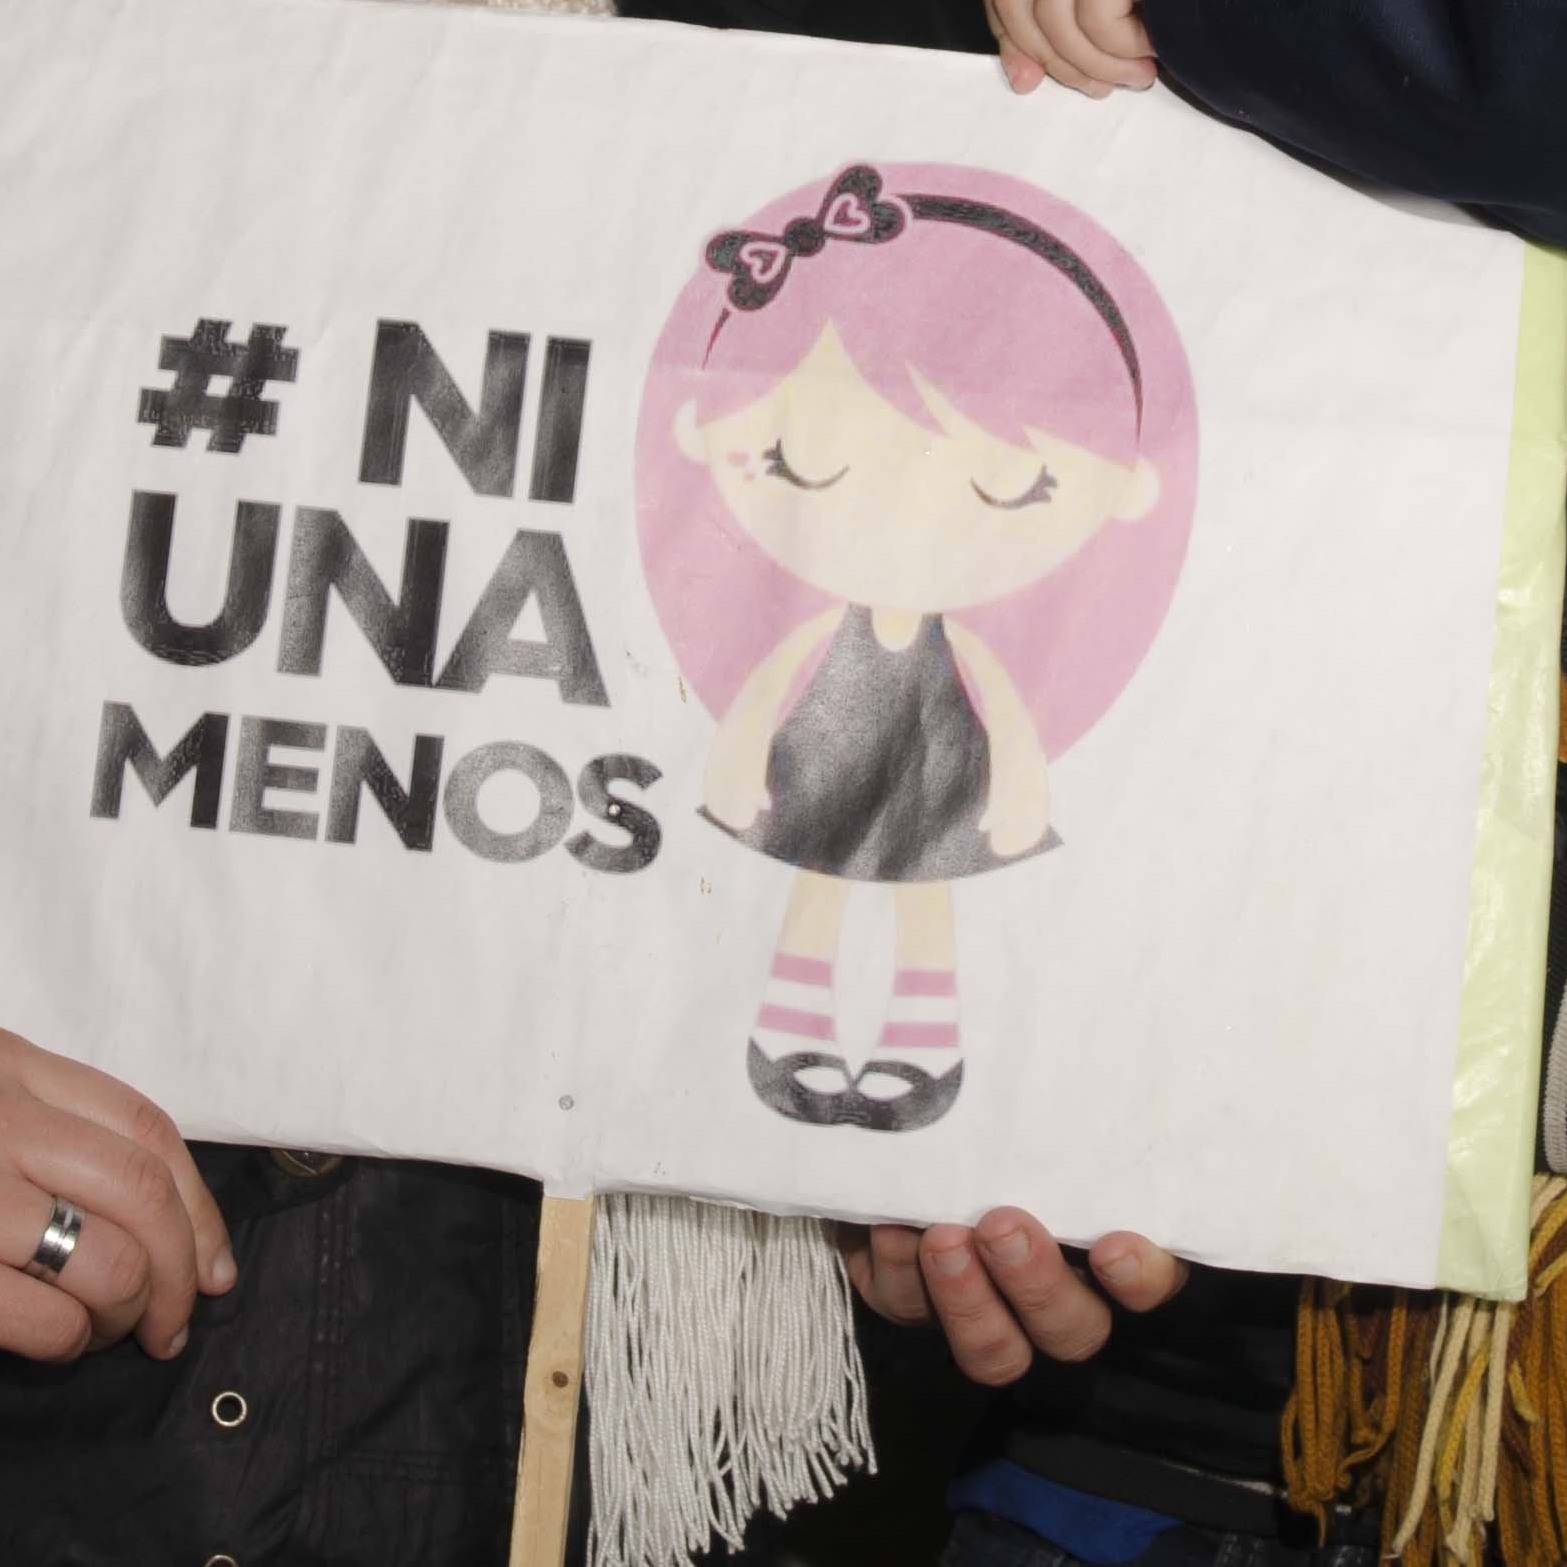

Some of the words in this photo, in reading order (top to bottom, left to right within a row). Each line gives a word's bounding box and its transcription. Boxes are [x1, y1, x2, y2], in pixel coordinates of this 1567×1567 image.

[137, 318, 300, 455] #
[358, 318, 592, 503] NI
[120, 489, 611, 708] UNA
[89, 700, 664, 874] MENOS
